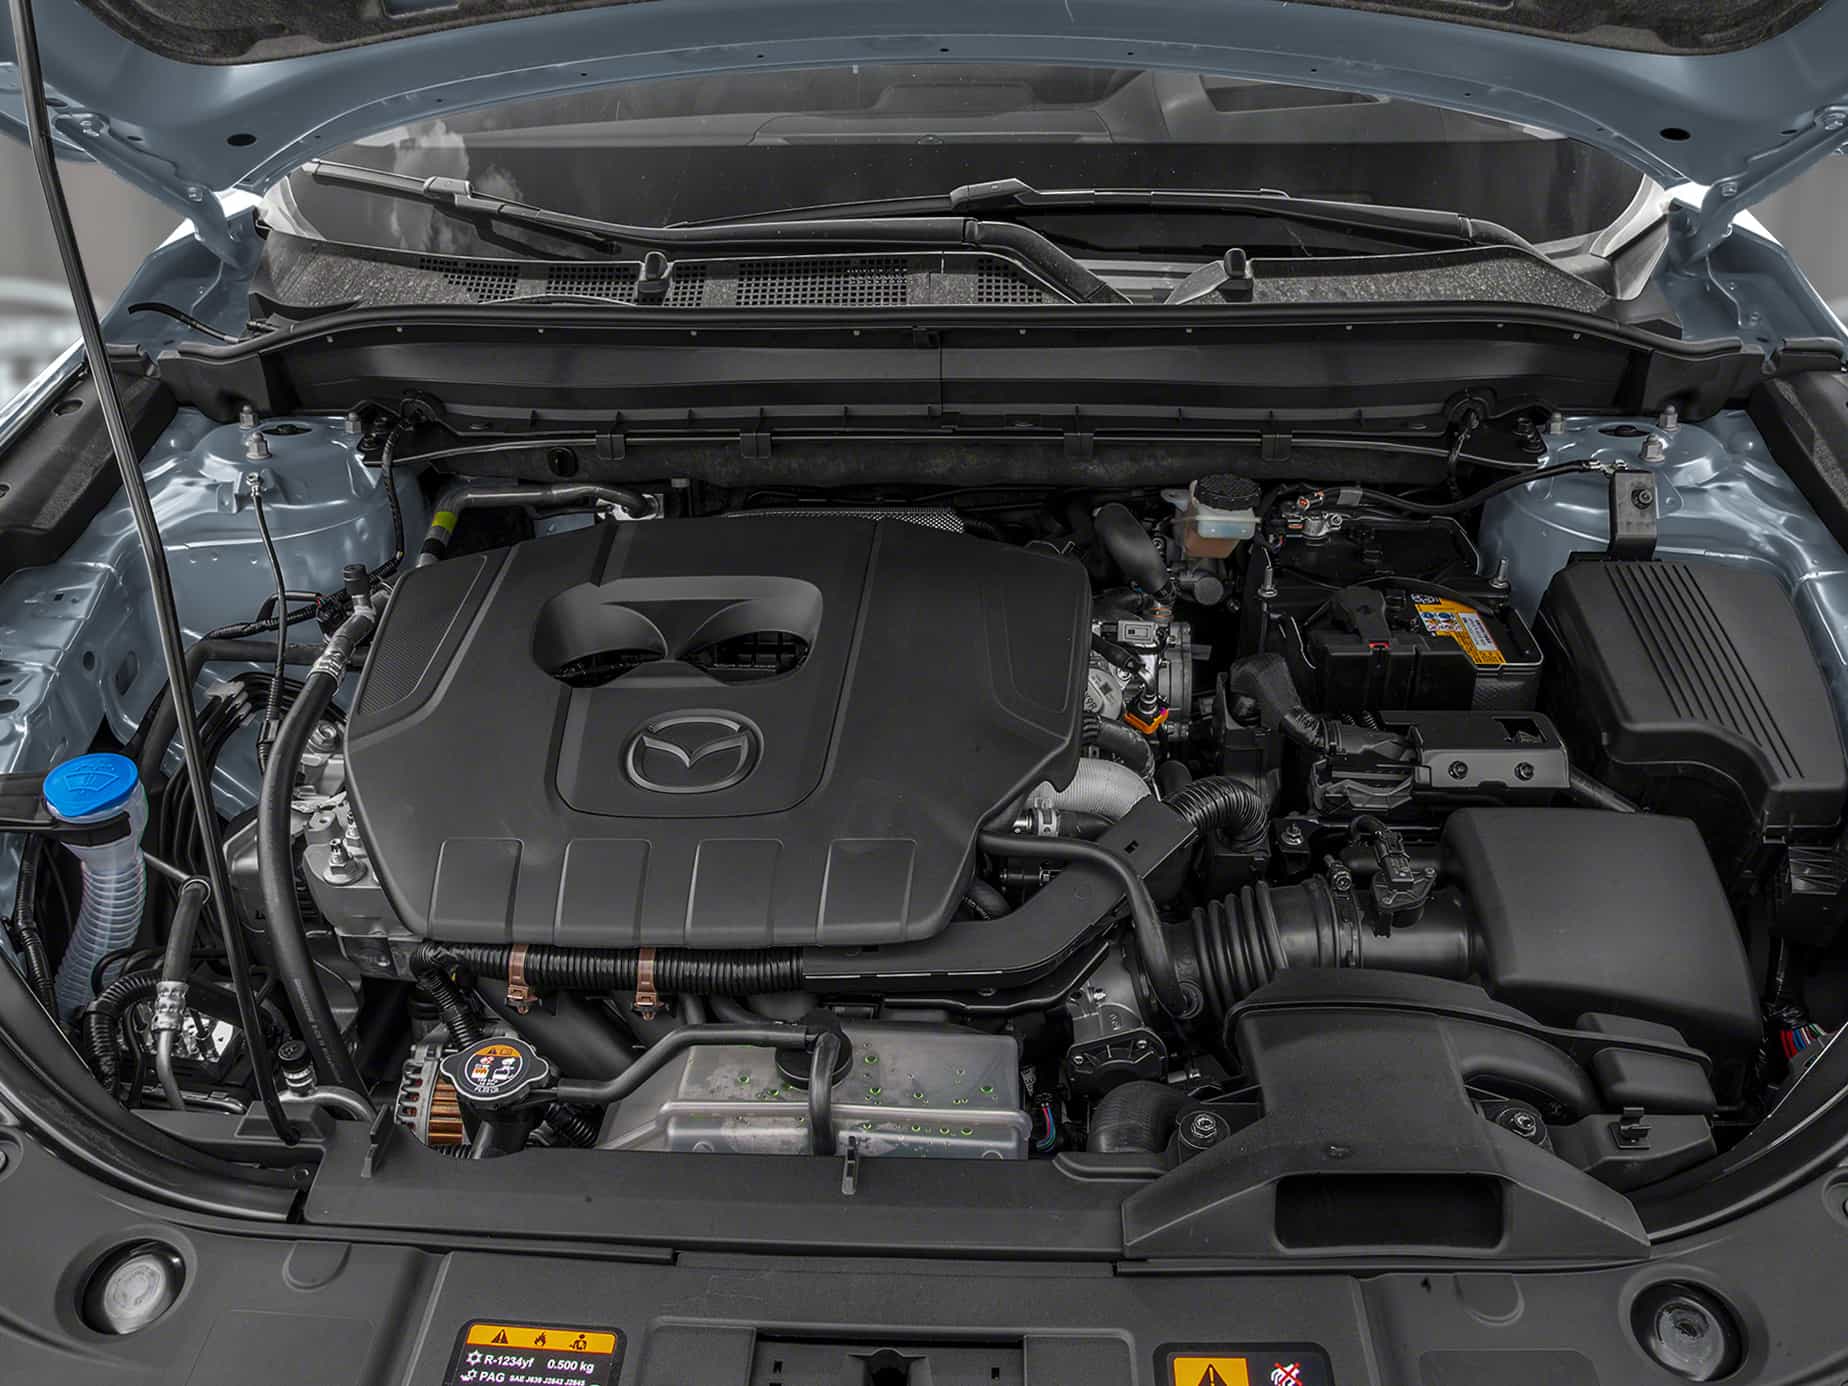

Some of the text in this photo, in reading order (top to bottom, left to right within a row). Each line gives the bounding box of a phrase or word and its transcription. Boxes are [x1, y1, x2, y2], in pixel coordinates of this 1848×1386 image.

[484, 1354, 595, 1374] R-1234yf 0.500 kg
[479, 1371, 506, 1383] PAG
